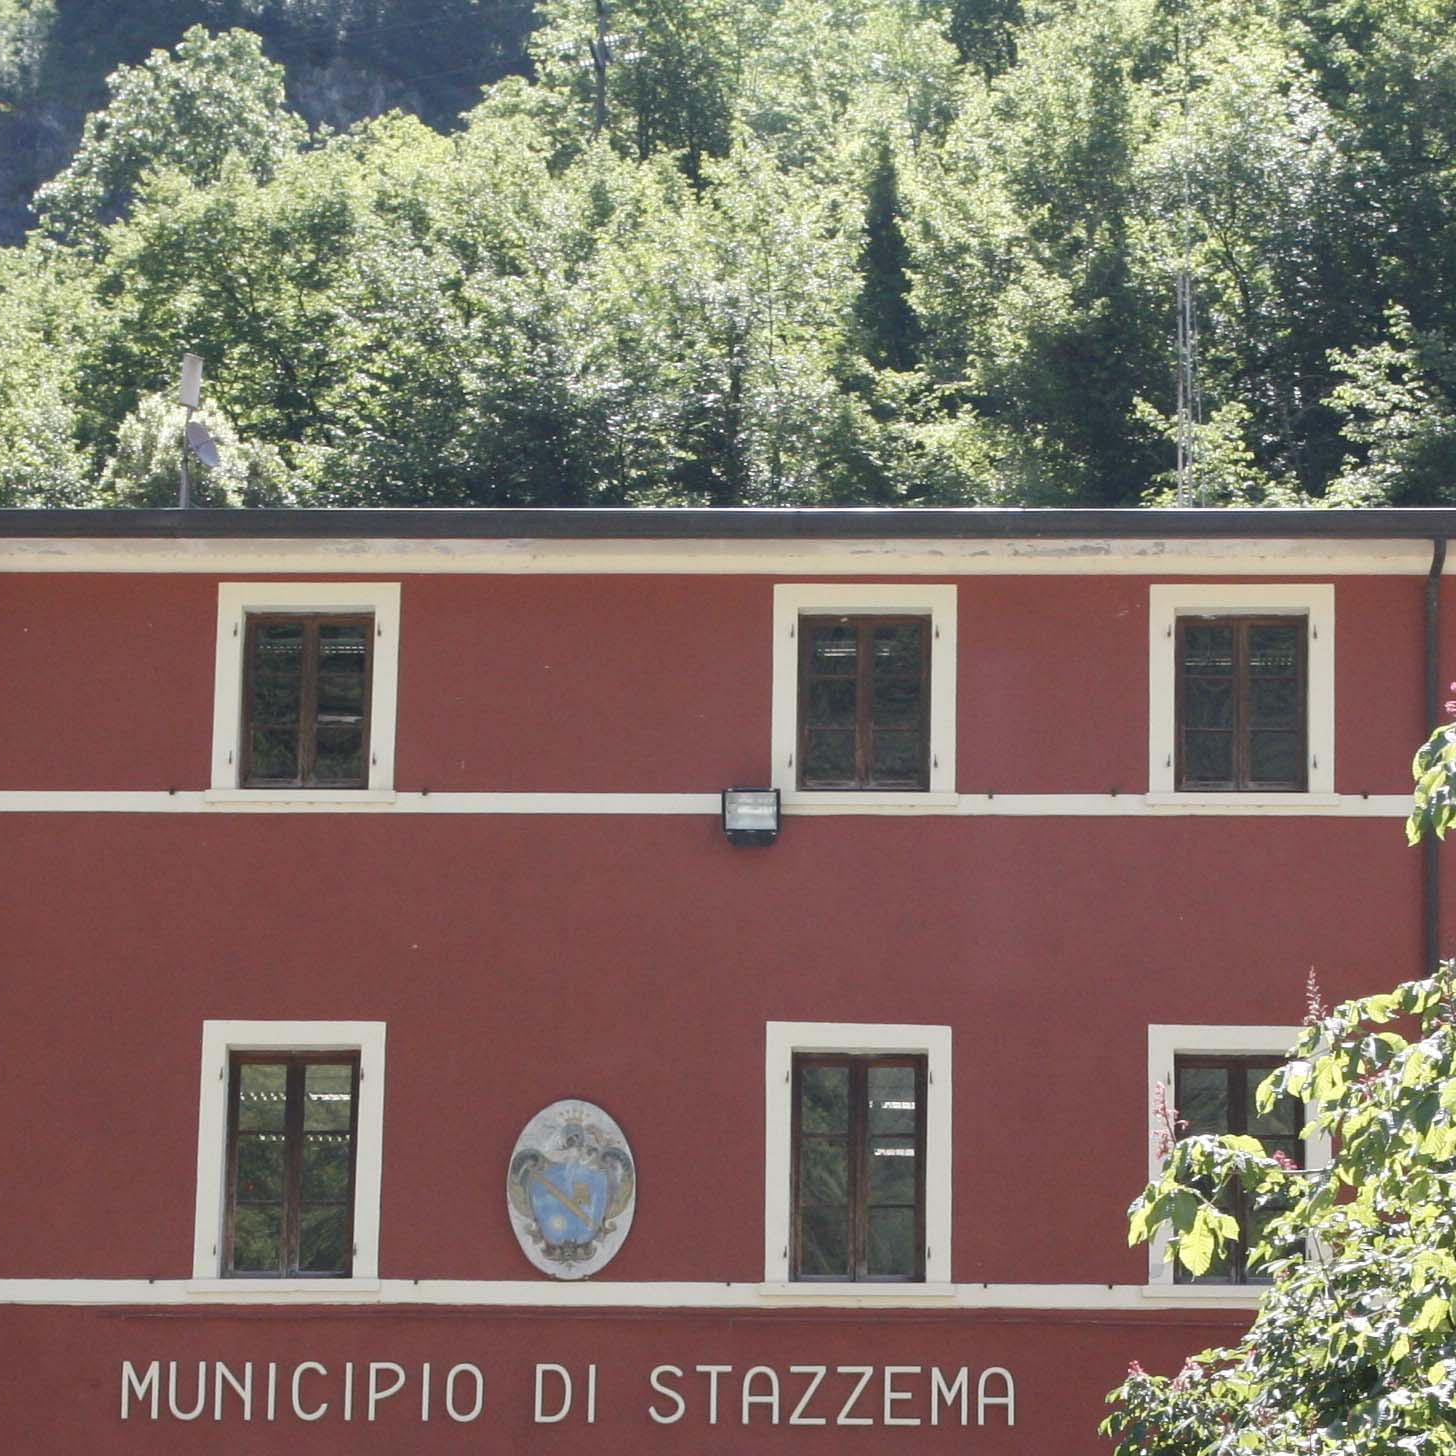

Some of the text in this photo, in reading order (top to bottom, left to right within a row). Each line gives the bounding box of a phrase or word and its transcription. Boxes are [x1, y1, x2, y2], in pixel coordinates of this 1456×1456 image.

[120, 1360, 1016, 1426] MUNICIPIO DI STAZZEMA
